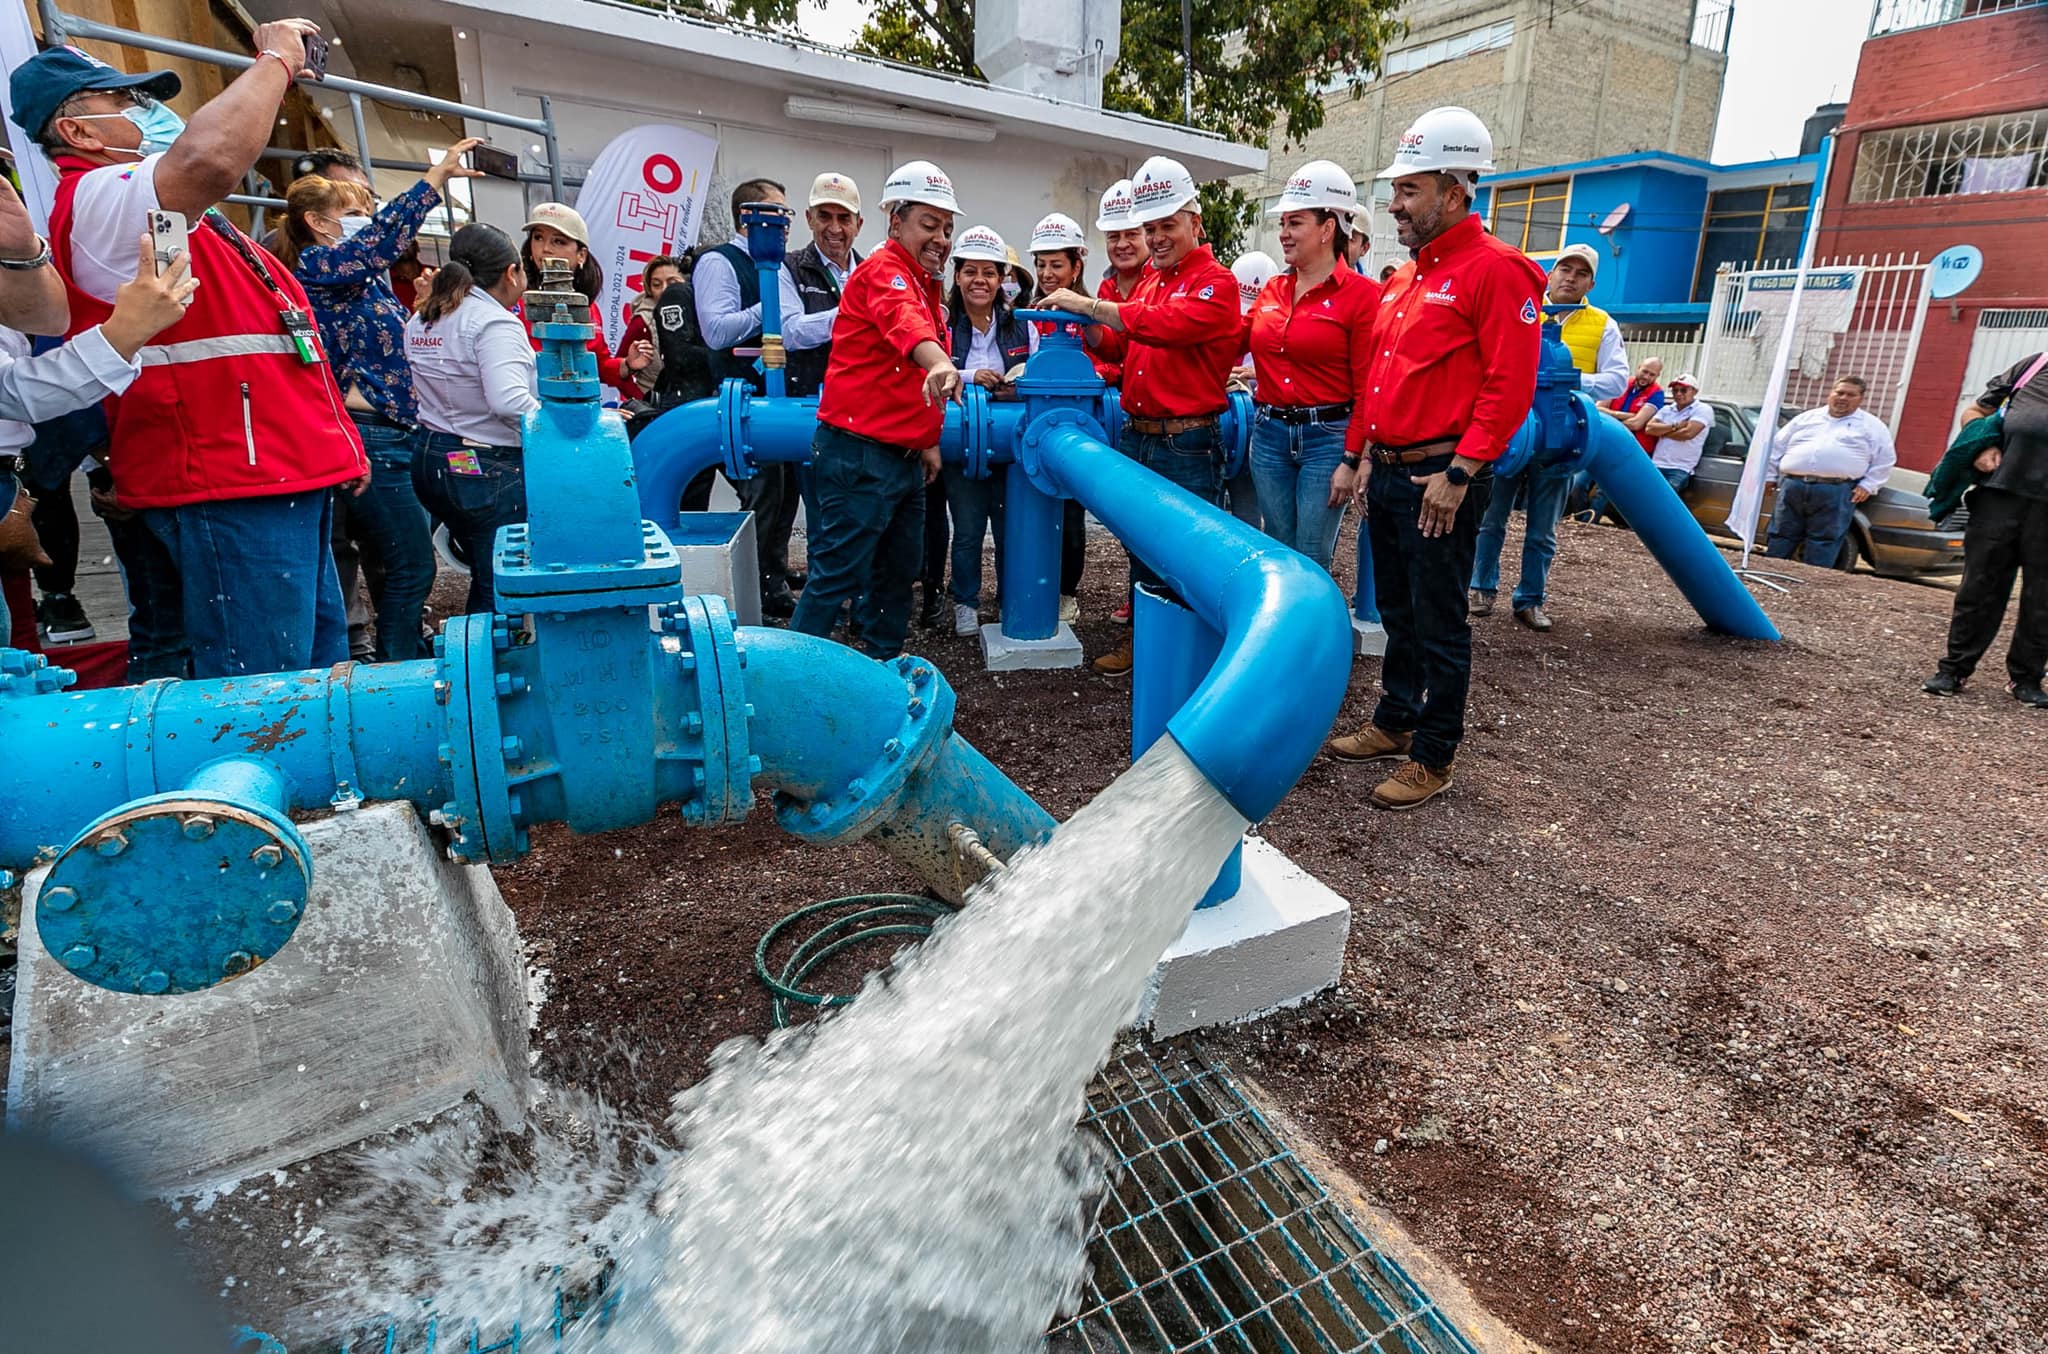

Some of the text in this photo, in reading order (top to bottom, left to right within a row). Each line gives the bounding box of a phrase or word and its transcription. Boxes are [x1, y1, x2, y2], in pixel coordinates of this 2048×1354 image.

[1442, 144, 1480, 153] Director General
[1134, 181, 1173, 197] SAPASAC
[1103, 197, 1132, 209] SAPASA
[963, 233, 1000, 245] SAPASAC
[616, 245, 626, 266] 2024
[613, 273, 623, 294] 2022
[1779, 274, 1841, 289] IMPTANTE
[609, 295, 622, 342] MUNICIPAL
[411, 336, 443, 347] SAPASAC
